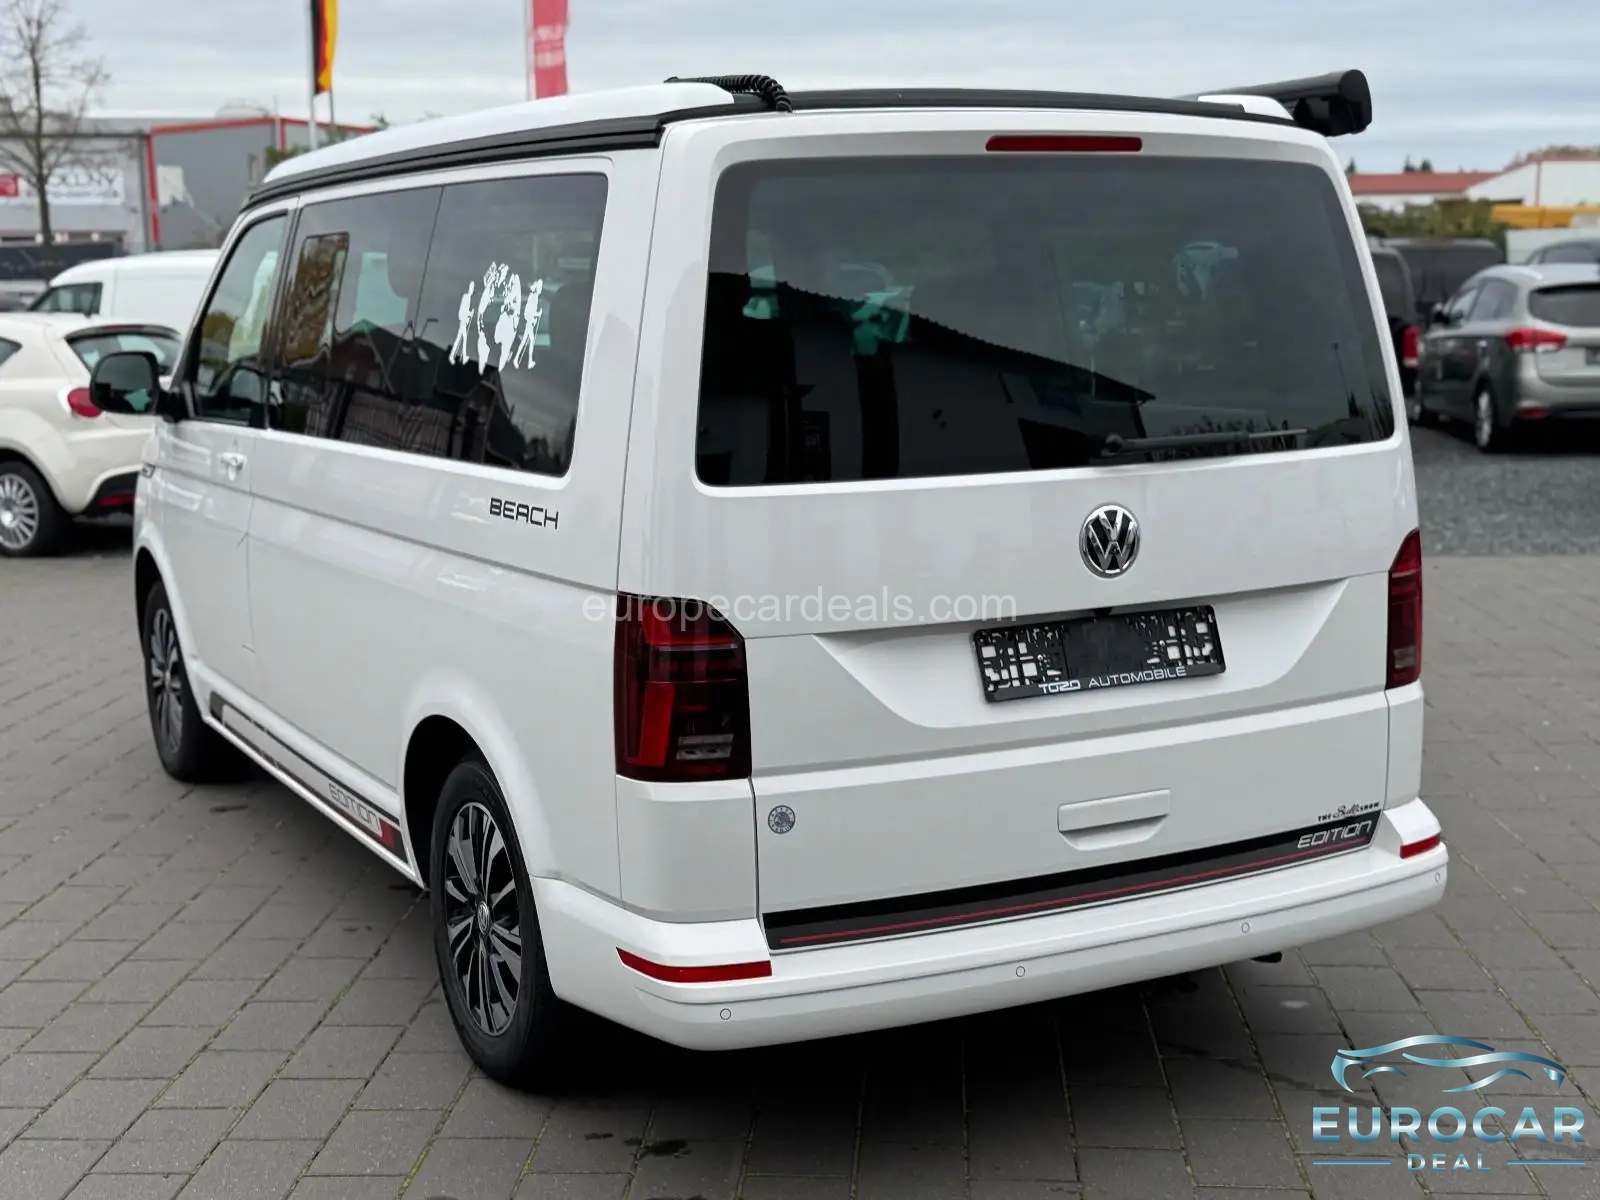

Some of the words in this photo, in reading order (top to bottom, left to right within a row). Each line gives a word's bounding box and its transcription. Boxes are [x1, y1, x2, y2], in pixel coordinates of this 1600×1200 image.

[489, 497, 559, 530] BEACH
[1088, 666, 1187, 688] AUTOMOBILE
[1297, 820, 1373, 849] EDITION
